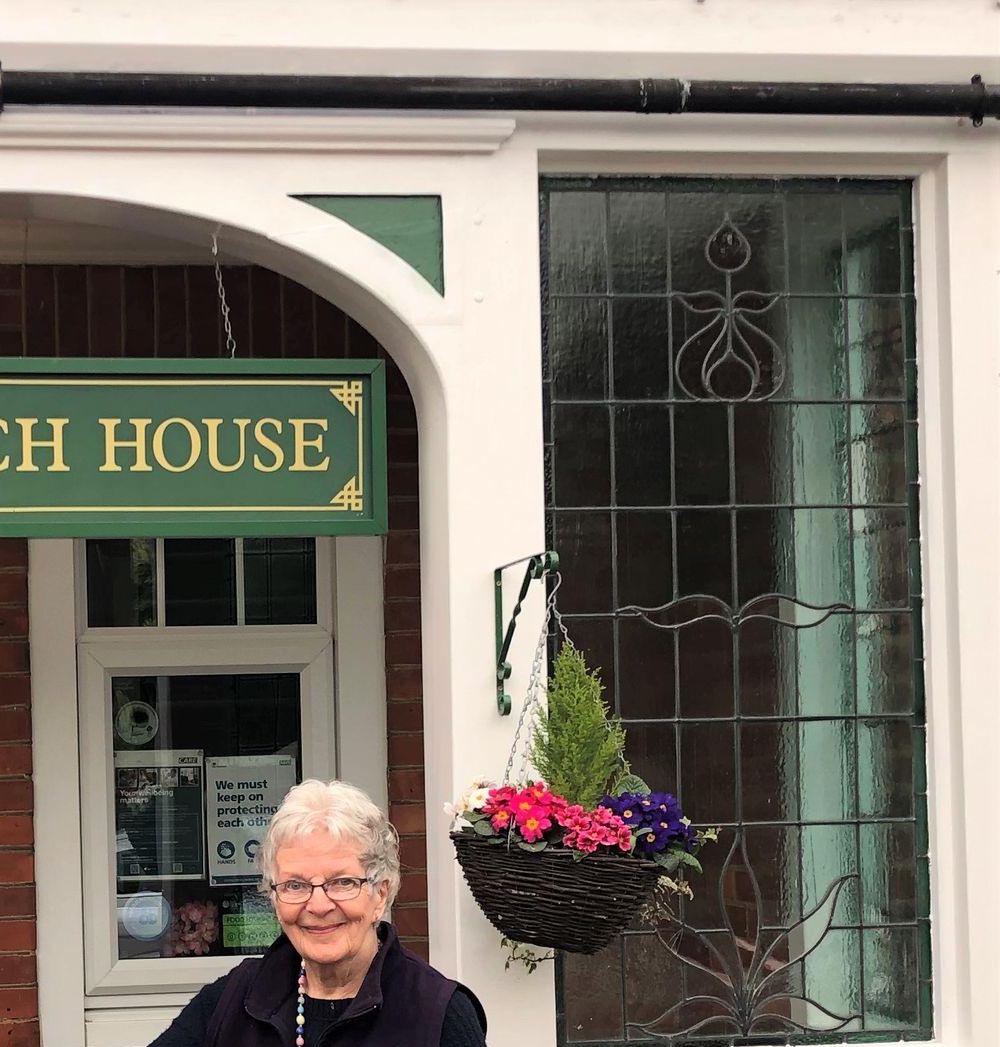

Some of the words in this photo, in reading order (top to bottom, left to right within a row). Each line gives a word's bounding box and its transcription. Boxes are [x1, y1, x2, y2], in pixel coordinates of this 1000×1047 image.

[97, 417, 330, 473] HOUSE
[215, 780, 234, 790] We
[237, 779, 268, 789] must
[217, 792, 245, 804] keep
[248, 793, 264, 801] on
[217, 804, 278, 818] protecting
[217, 817, 244, 828] each
